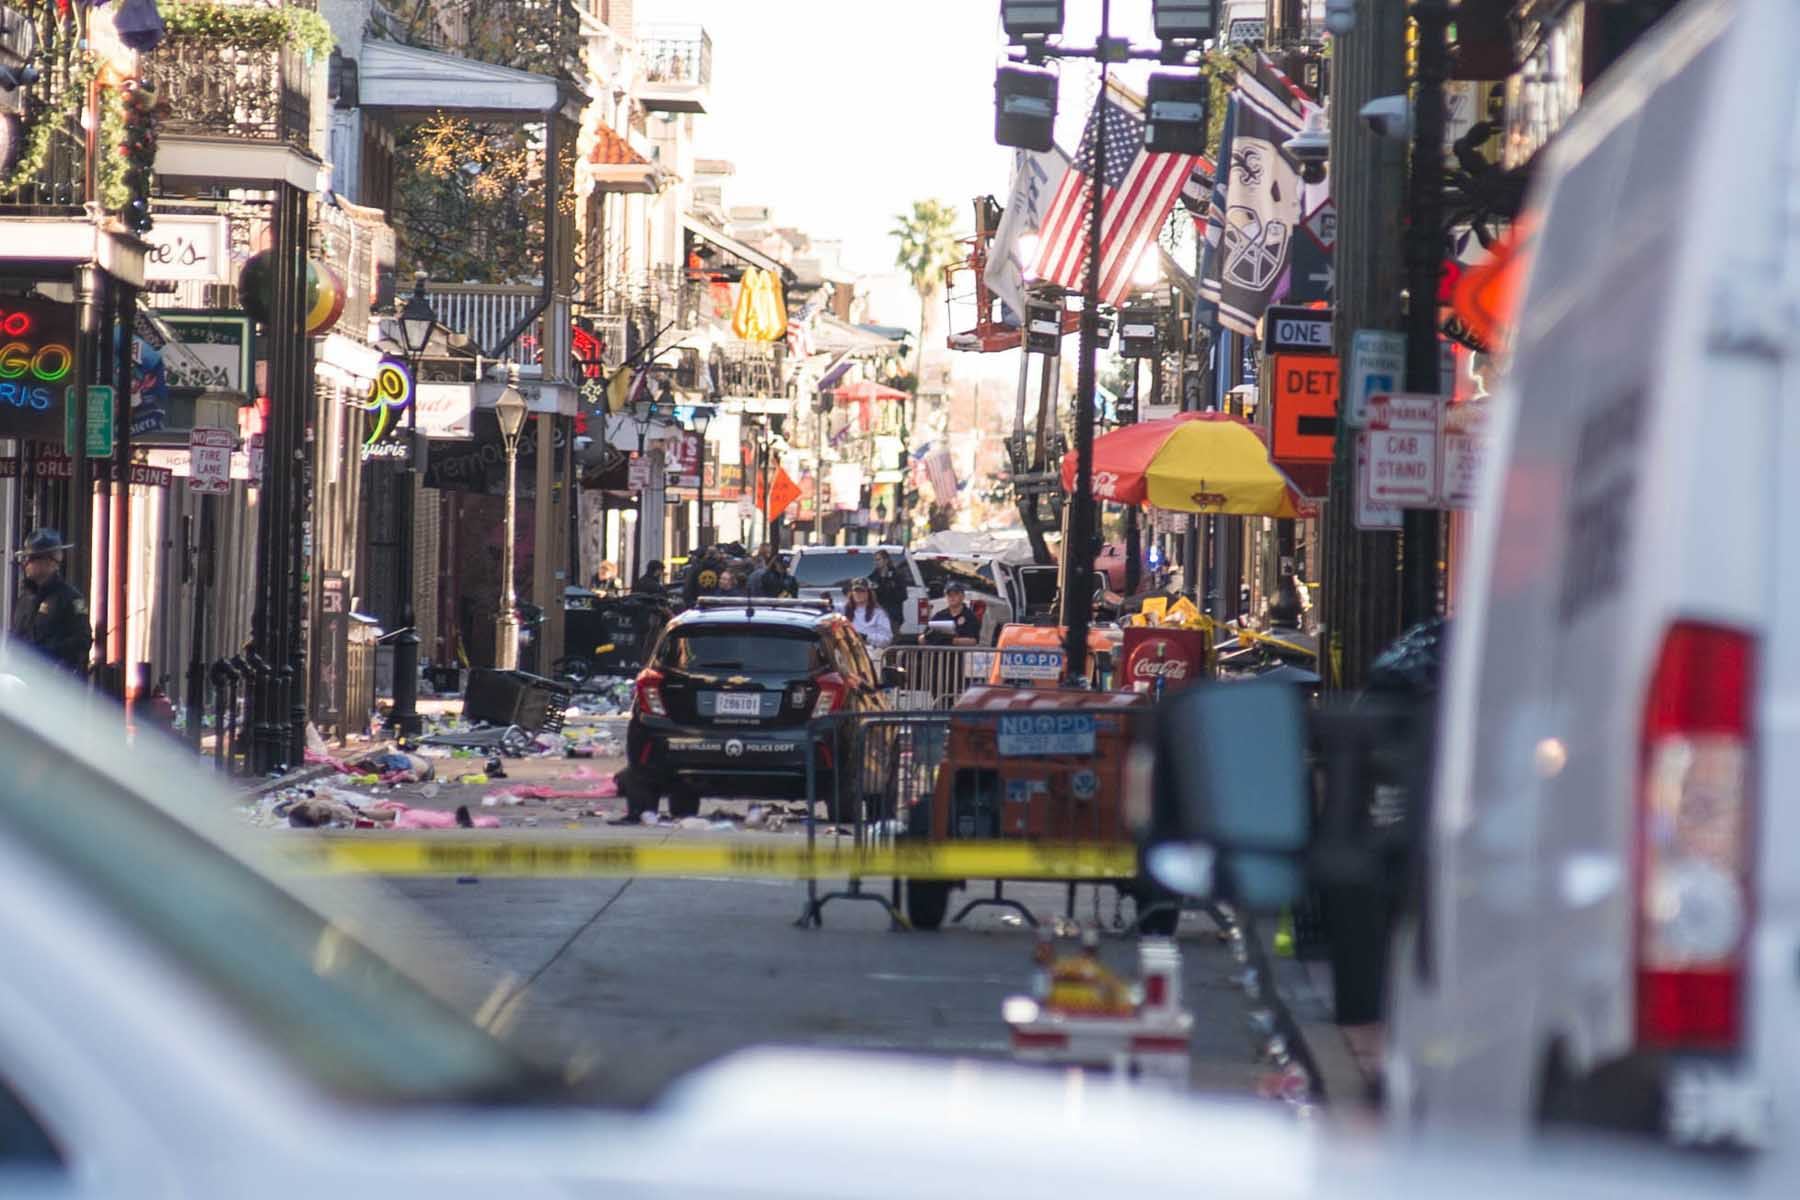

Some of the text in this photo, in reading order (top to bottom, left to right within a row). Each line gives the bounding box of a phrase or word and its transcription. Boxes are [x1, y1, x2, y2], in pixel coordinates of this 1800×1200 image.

[1281, 322, 1322, 342] ONE
[1287, 369, 1336, 394] DET
[361, 440, 408, 460] quiris
[1387, 436, 1418, 454] CAB
[200, 450, 222, 461] FIRE
[196, 464, 222, 475] LANE
[1377, 461, 1427, 479] STAND
[746, 743, 773, 752] POLICE
[774, 744, 795, 752] DEPT
